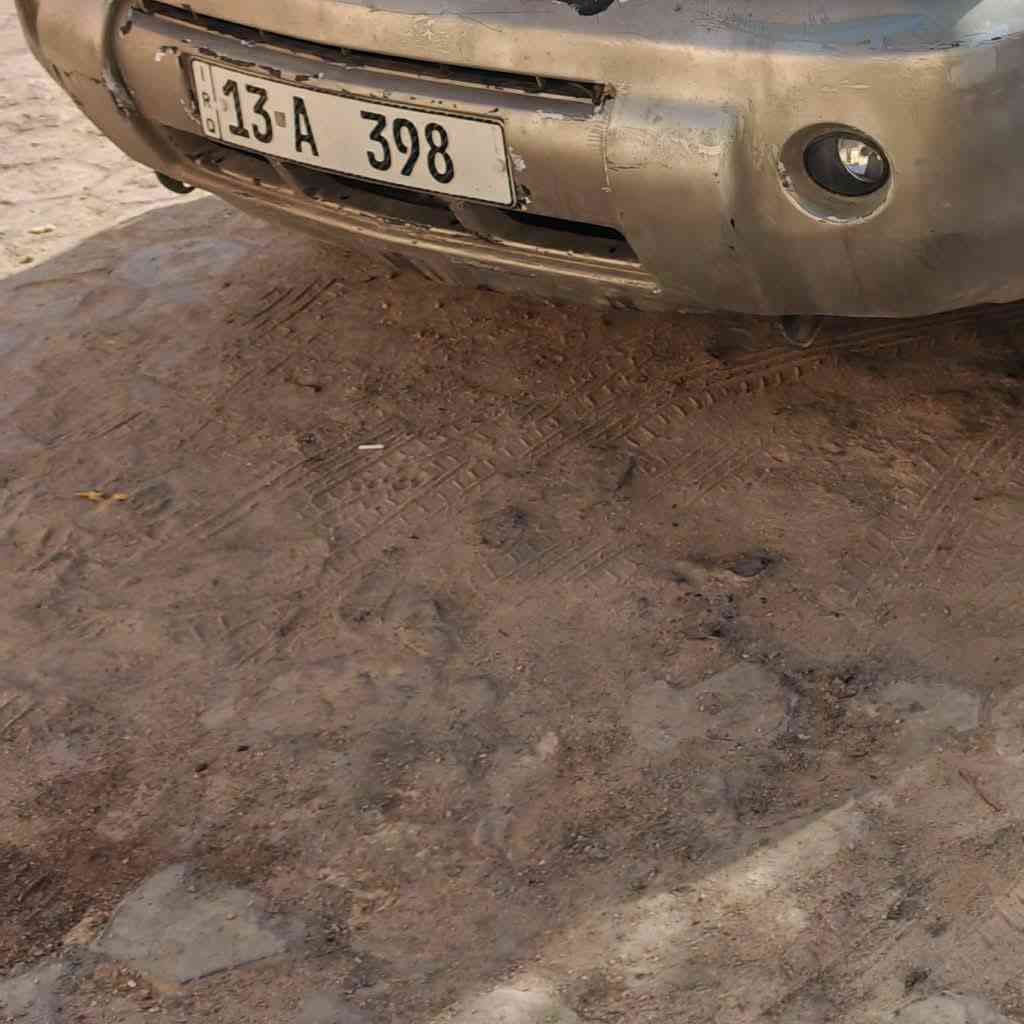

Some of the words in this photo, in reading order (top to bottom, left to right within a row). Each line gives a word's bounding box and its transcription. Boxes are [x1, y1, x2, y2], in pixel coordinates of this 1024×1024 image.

[222, 79, 273, 144] 13
[293, 96, 320, 157] A
[360, 109, 455, 184] 398
